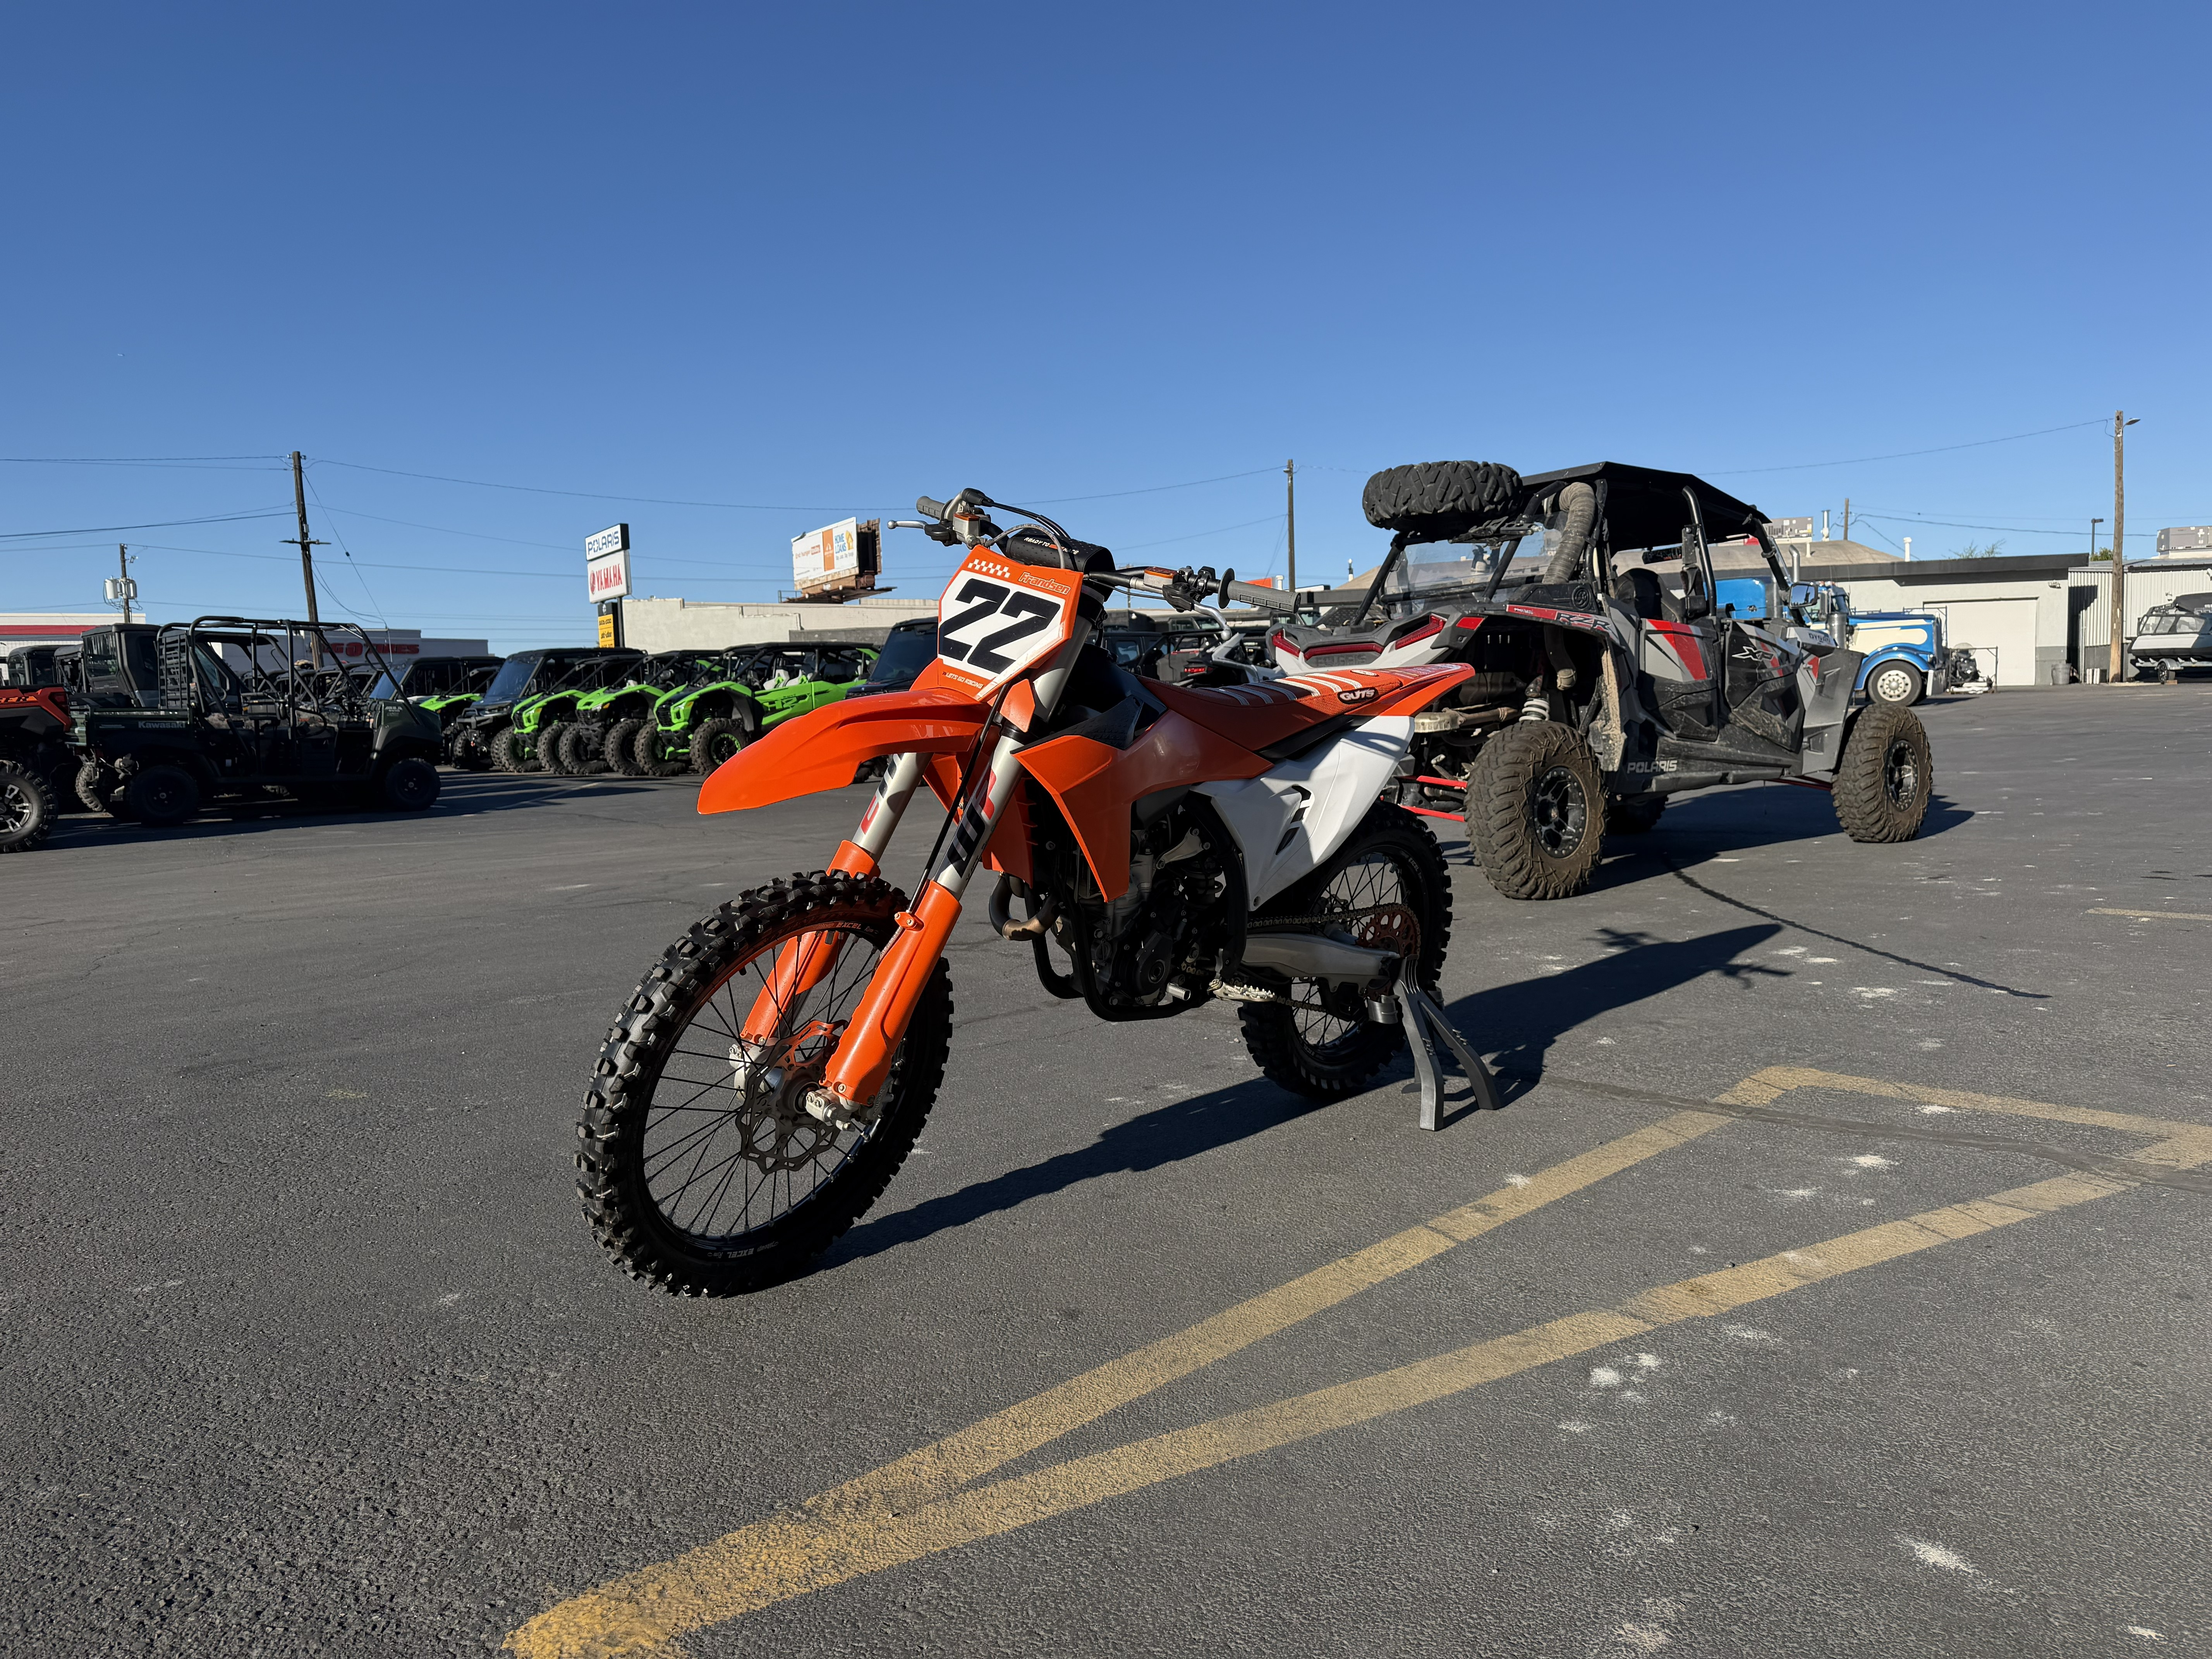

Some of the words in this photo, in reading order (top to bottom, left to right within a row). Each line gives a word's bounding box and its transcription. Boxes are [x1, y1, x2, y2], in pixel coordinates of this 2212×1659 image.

[588, 531, 619, 555] POLARIS
[835, 533, 845, 544] HOME
[835, 542, 847, 554] LOANS
[596, 563, 622, 591] YAMAHA
[1018, 572, 1071, 595] Frandsen
[938, 578, 1061, 674] 22
[346, 642, 363, 656] O
[964, 678, 984, 689] RACING
[1340, 689, 1375, 701] GUTS
[1627, 760, 1678, 774] POLARIS
[727, 1248, 754, 1258] EXCEL
